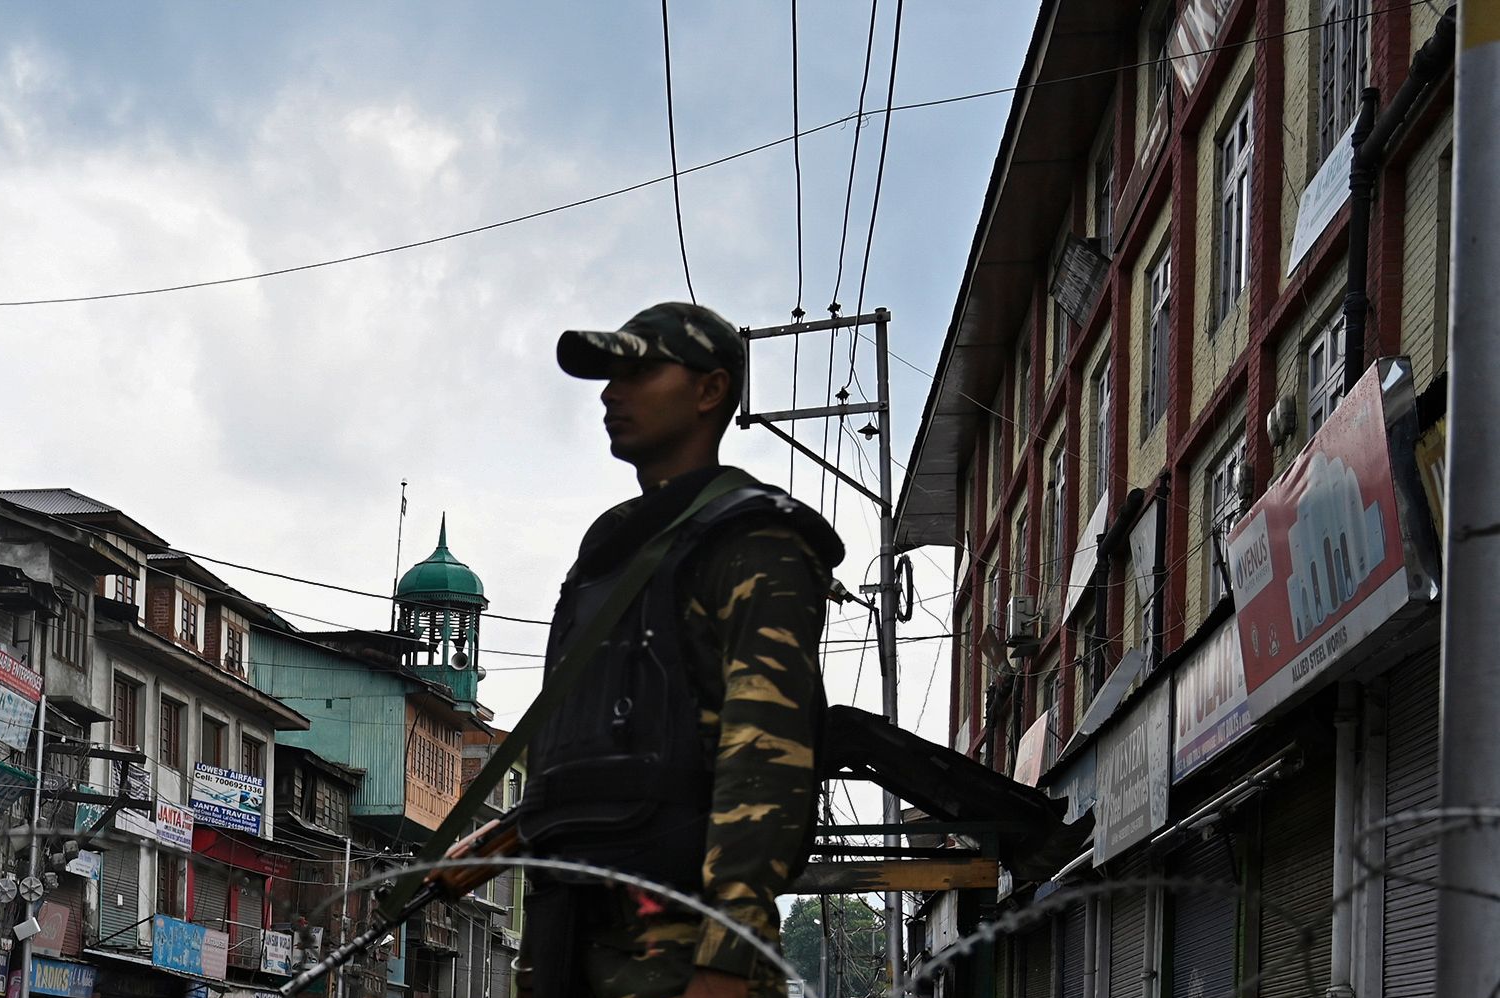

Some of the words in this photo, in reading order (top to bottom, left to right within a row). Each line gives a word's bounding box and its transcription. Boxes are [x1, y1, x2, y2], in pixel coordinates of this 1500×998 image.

[1240, 533, 1268, 578] VENUS
[1292, 661, 1310, 684] ALLIED
[1309, 643, 1326, 671] STEEL
[1326, 626, 1348, 656] WORKS
[12, 661, 43, 691] ENTERPRISES
[195, 772, 212, 782] Cell:
[215, 777, 262, 794] 7006921336
[196, 763, 228, 777] LOWEST
[230, 771, 263, 785] AIRFARE
[158, 805, 182, 828] JANTA
[193, 802, 219, 813] JANTA
[221, 808, 256, 822] TRAVELS
[36, 963, 69, 992] RADIOS
